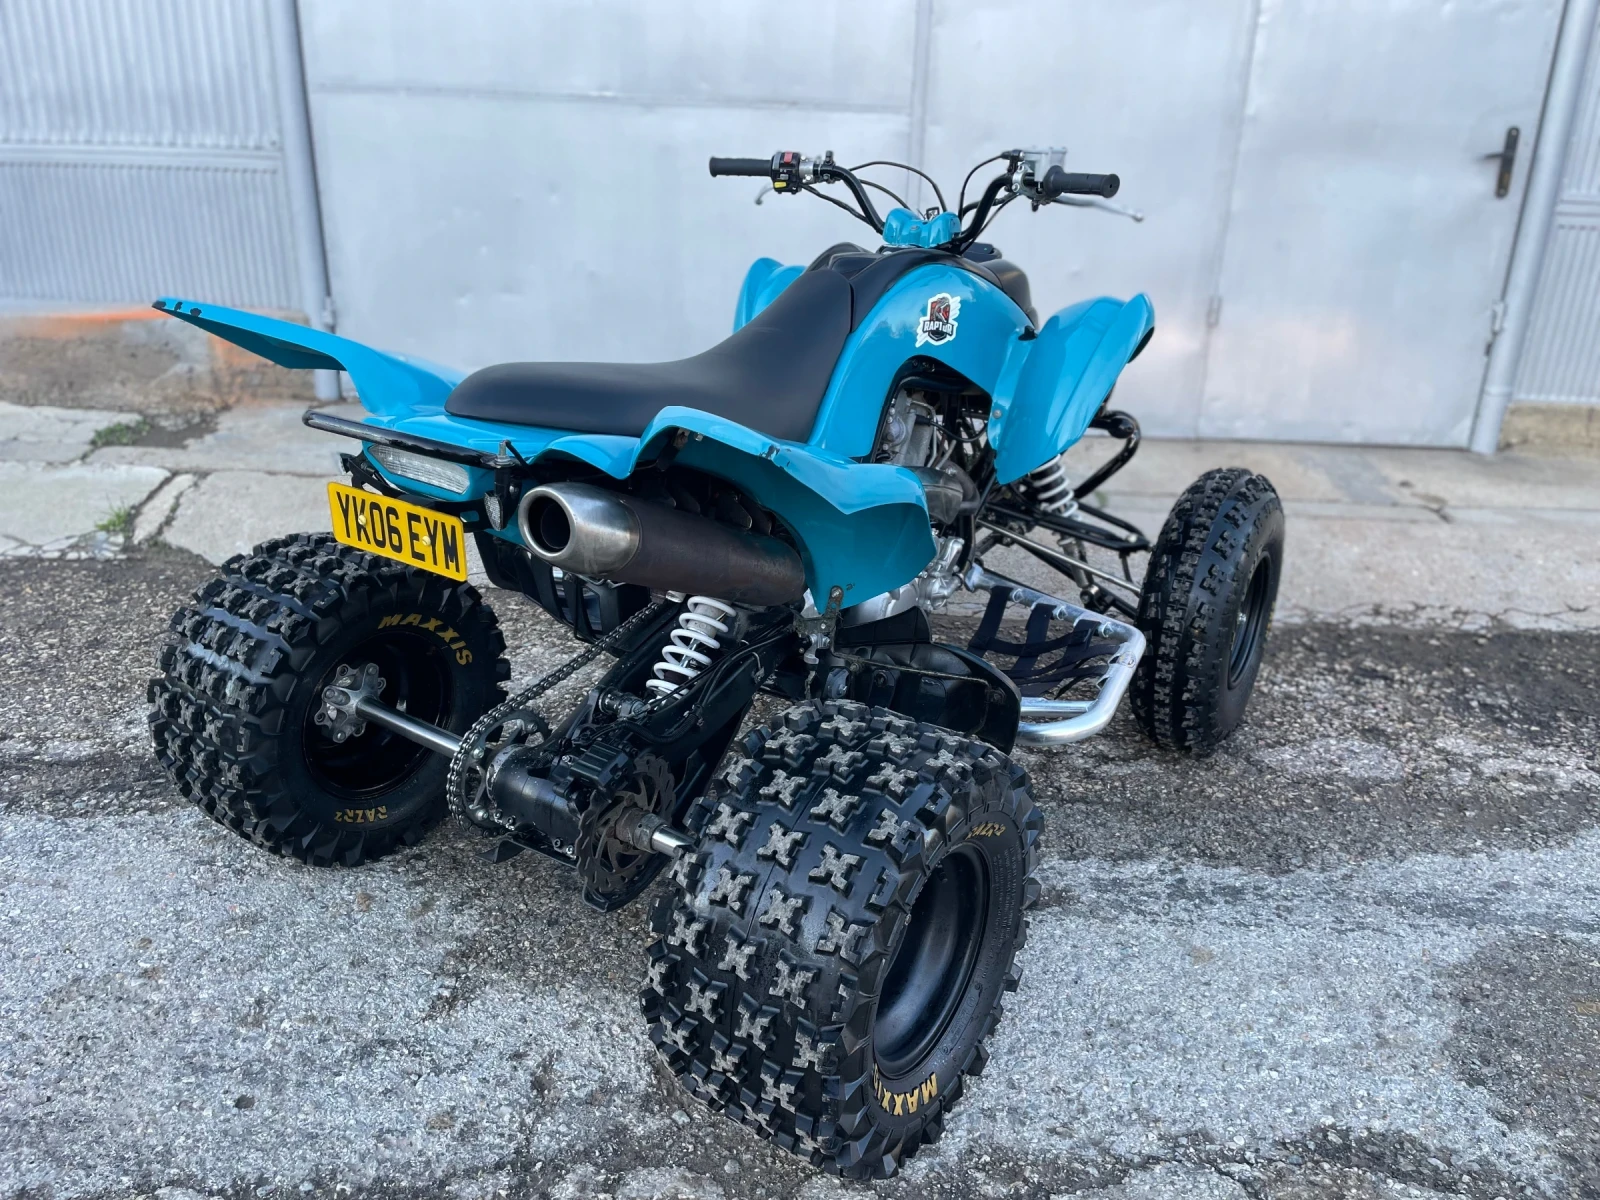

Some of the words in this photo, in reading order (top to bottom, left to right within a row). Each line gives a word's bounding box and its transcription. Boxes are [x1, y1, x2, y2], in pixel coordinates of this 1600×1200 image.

[336, 491, 403, 555] YK06
[406, 511, 460, 574] EYM
[377, 613, 473, 665] MAXXIS
